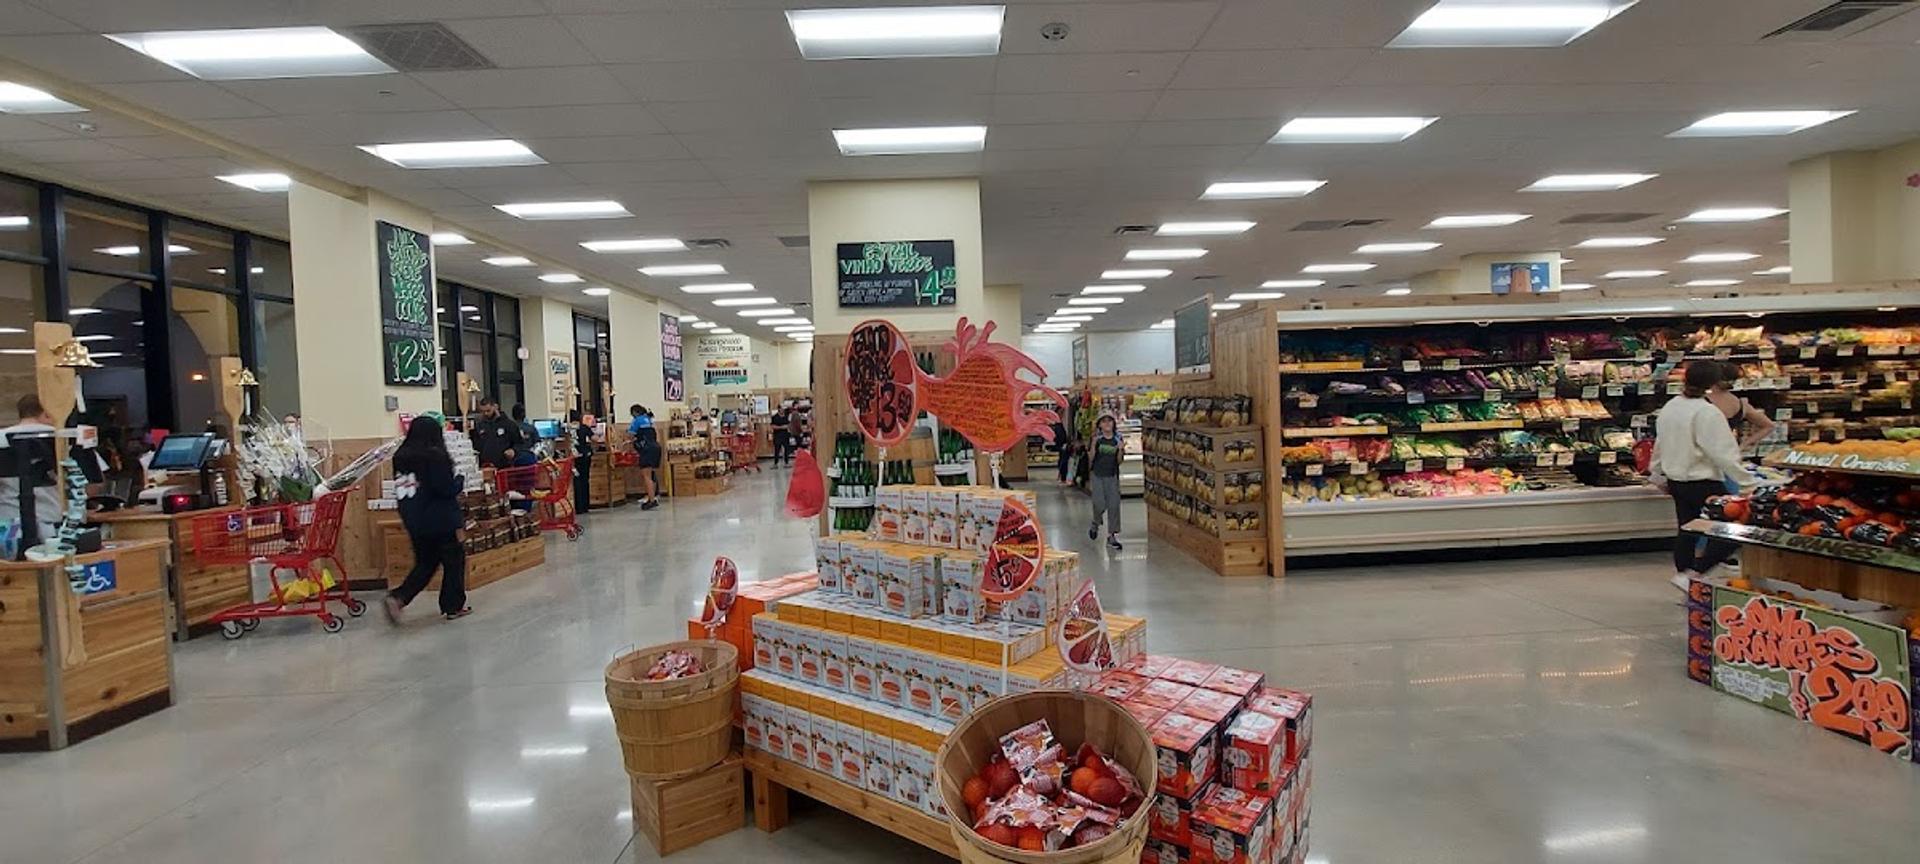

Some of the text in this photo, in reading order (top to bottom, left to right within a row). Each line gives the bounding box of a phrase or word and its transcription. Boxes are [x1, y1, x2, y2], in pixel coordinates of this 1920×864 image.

[840, 259, 884, 274] VINHO
[1783, 450, 1911, 472] Navel Oranges
[1714, 627, 1880, 675] ORANGES
